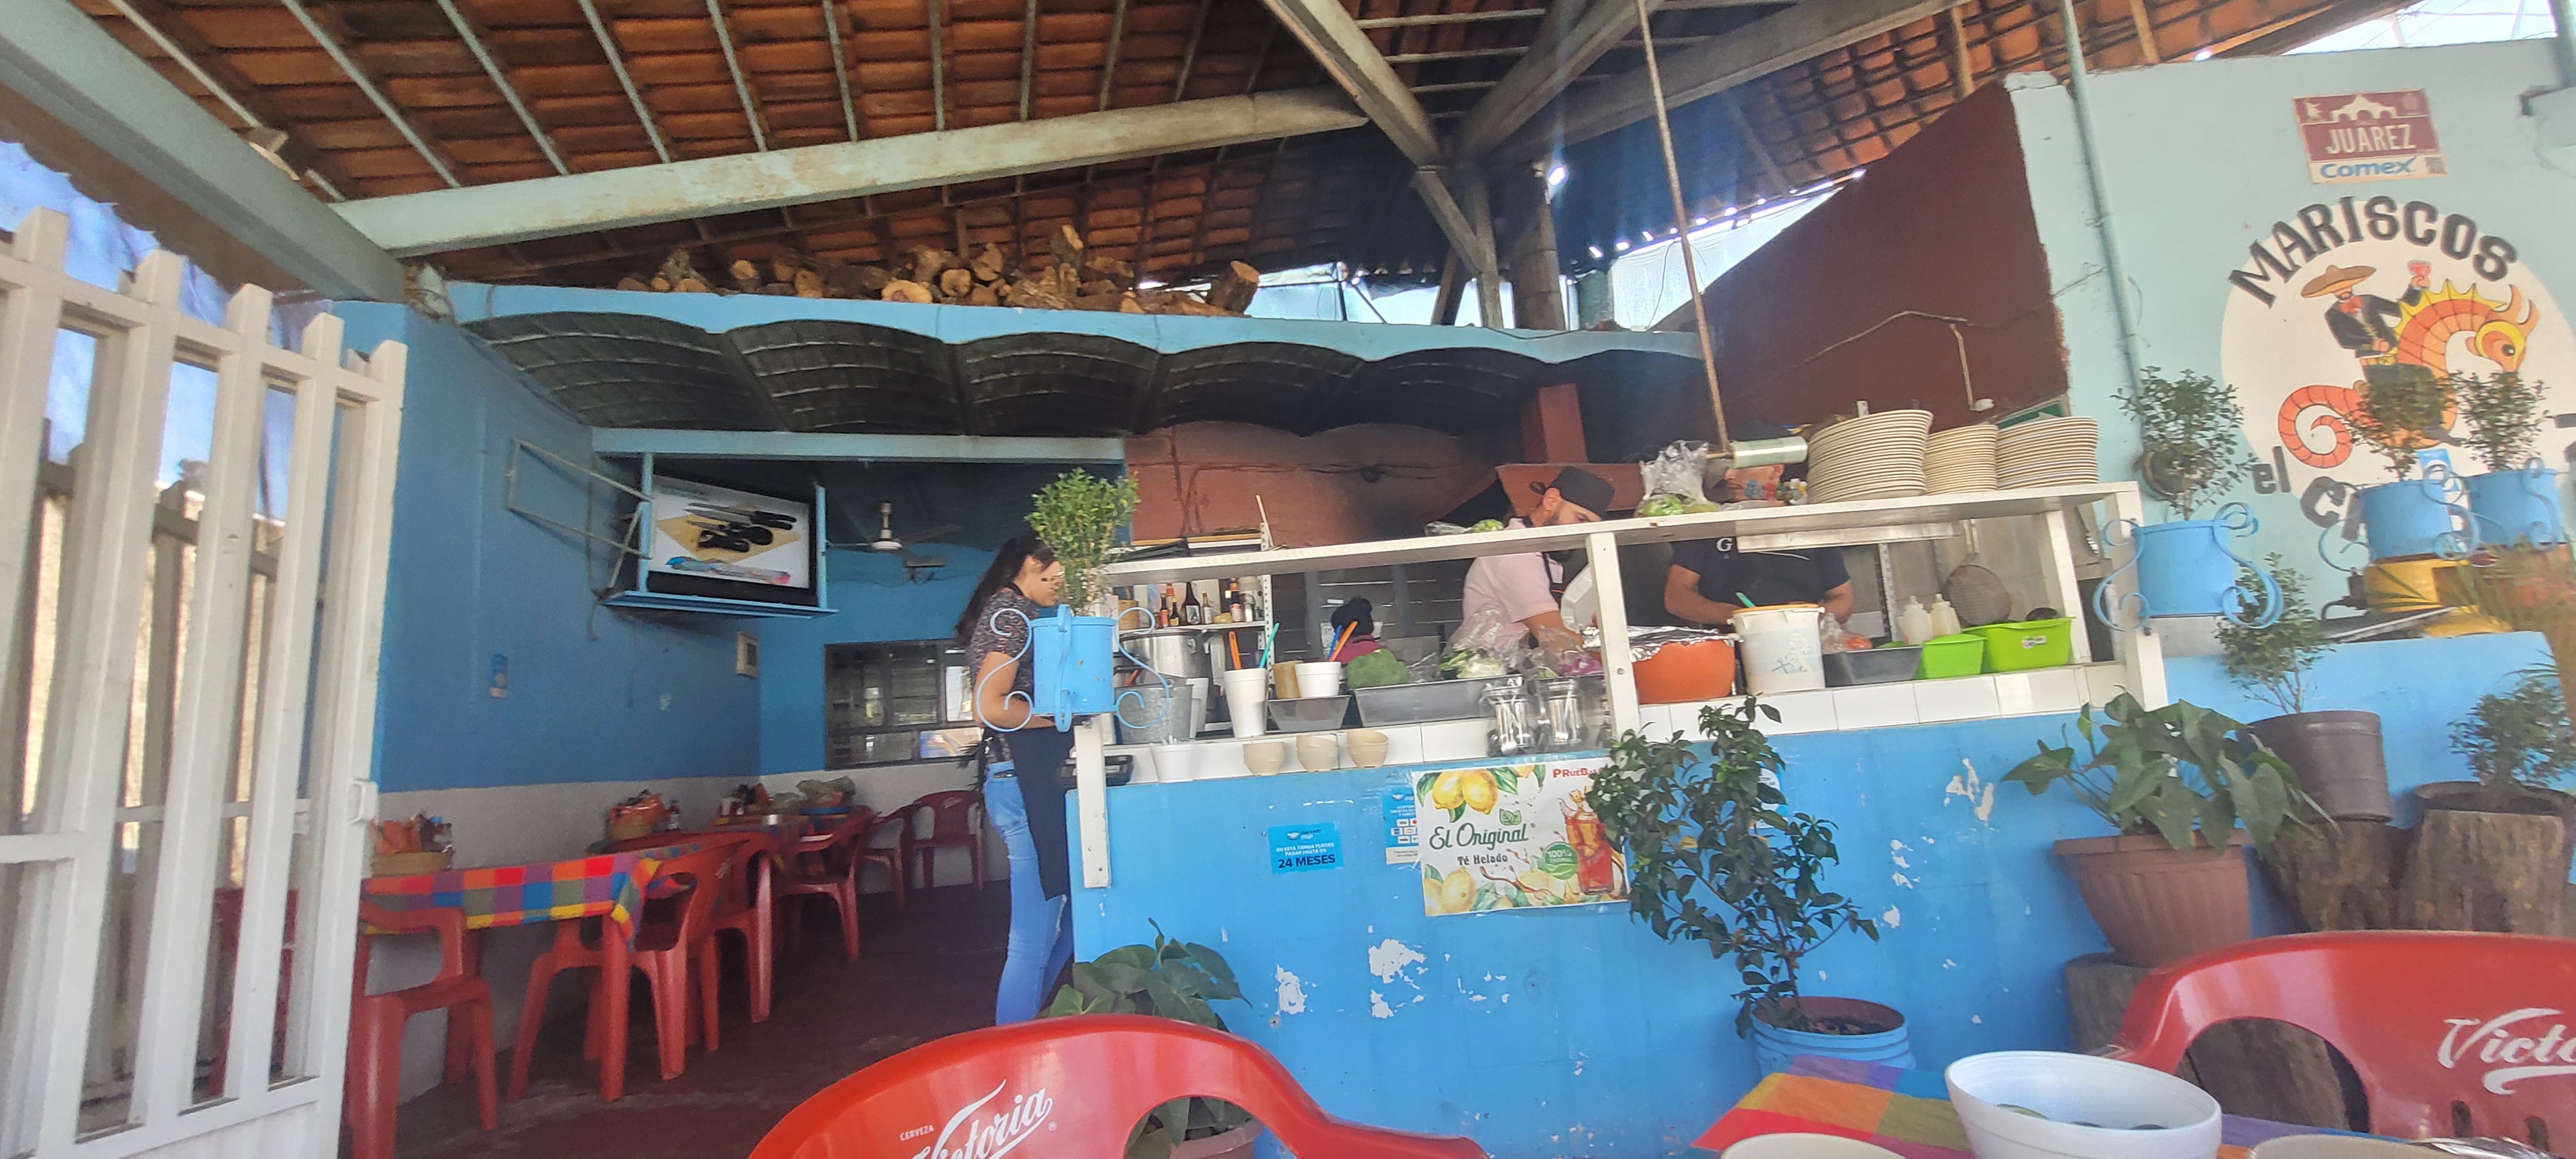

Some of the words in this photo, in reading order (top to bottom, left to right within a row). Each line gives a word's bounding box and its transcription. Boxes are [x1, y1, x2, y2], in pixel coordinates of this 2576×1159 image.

[2228, 195, 2517, 309] MARISCOS
[2252, 446, 2291, 495] el
[1429, 826, 1453, 850] El
[1456, 822, 1530, 851] Original
[1278, 858, 1293, 869] 24
[1296, 854, 1336, 867] MESES
[1457, 856, 1470, 865] Té
[1473, 853, 1508, 865] Helado
[1547, 849, 1572, 858] 100%
[900, 1125, 934, 1141] CERVEZA
